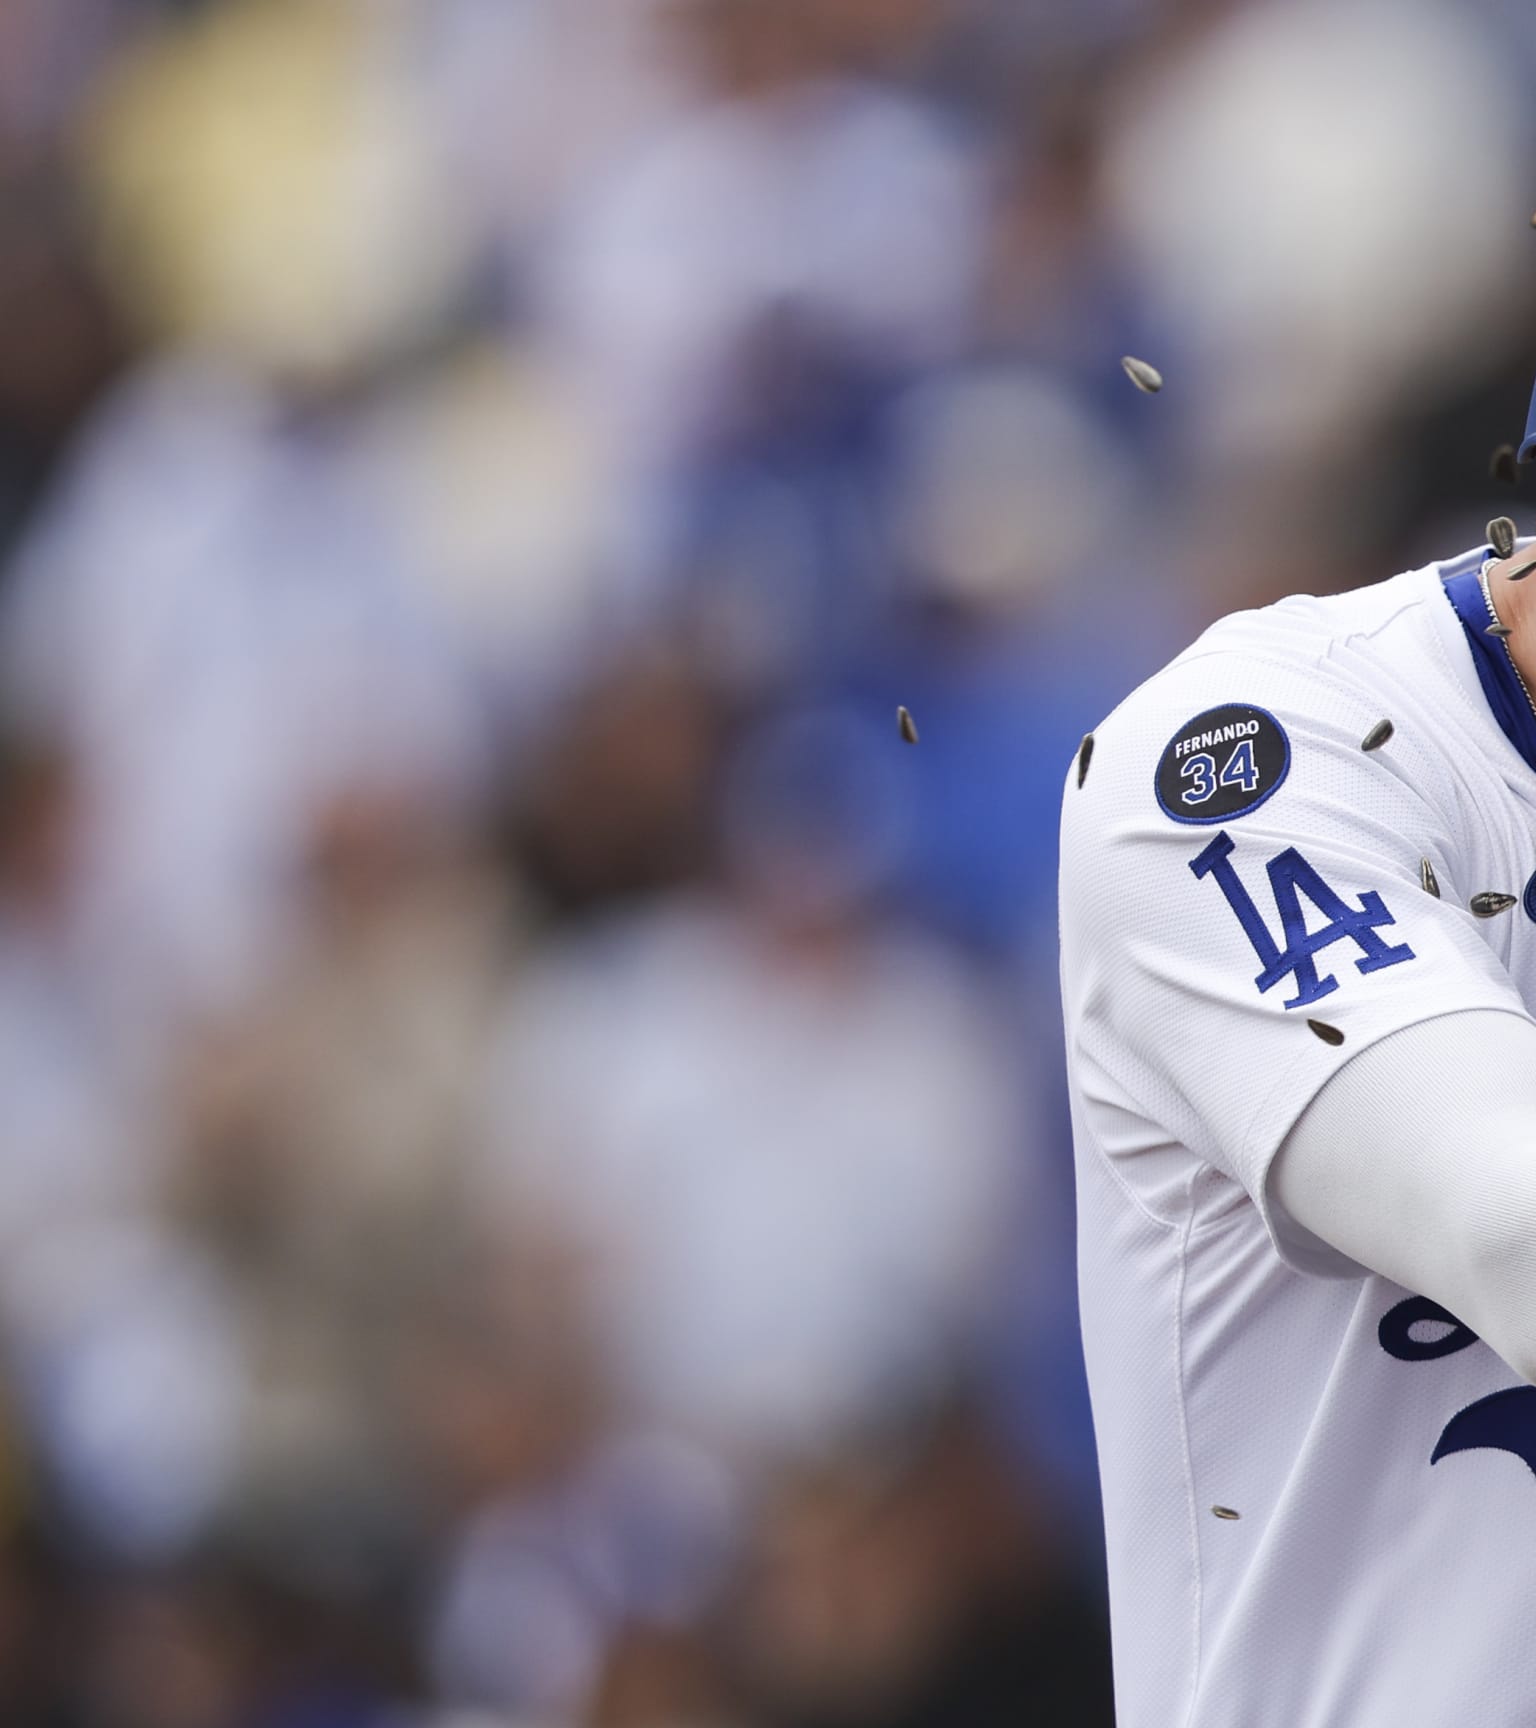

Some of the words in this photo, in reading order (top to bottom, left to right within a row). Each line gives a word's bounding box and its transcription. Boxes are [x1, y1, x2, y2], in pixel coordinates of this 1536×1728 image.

[1175, 719, 1260, 759] FERNANDO
[1180, 739, 1260, 806] 34
[1188, 830, 1417, 1010] LA
